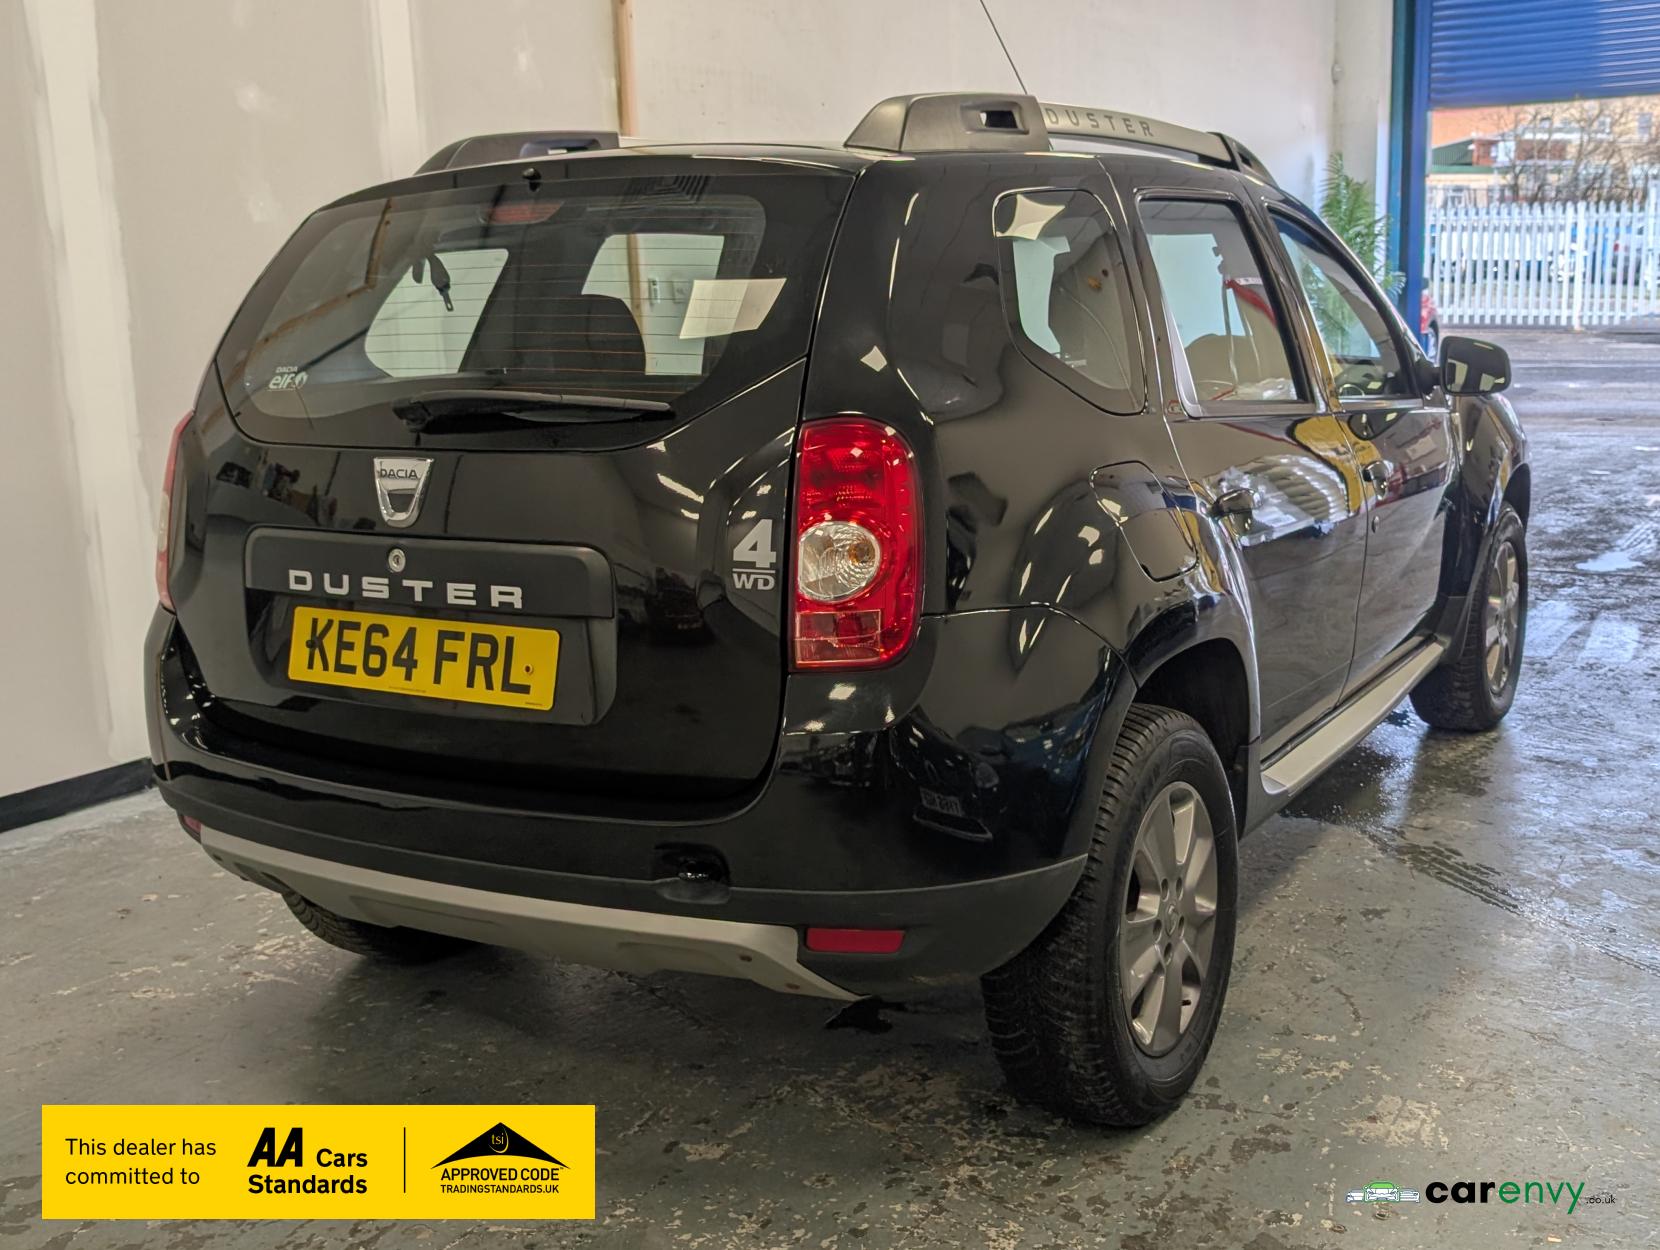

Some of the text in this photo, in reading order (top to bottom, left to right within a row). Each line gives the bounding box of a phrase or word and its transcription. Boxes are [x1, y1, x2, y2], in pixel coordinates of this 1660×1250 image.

[1044, 107, 1154, 137] DUSTER
[380, 468, 418, 479] DACIA
[733, 519, 776, 568] 4
[288, 569, 523, 609] DUSTER
[732, 573, 775, 591] WD
[306, 617, 531, 695] KE64 FRL
